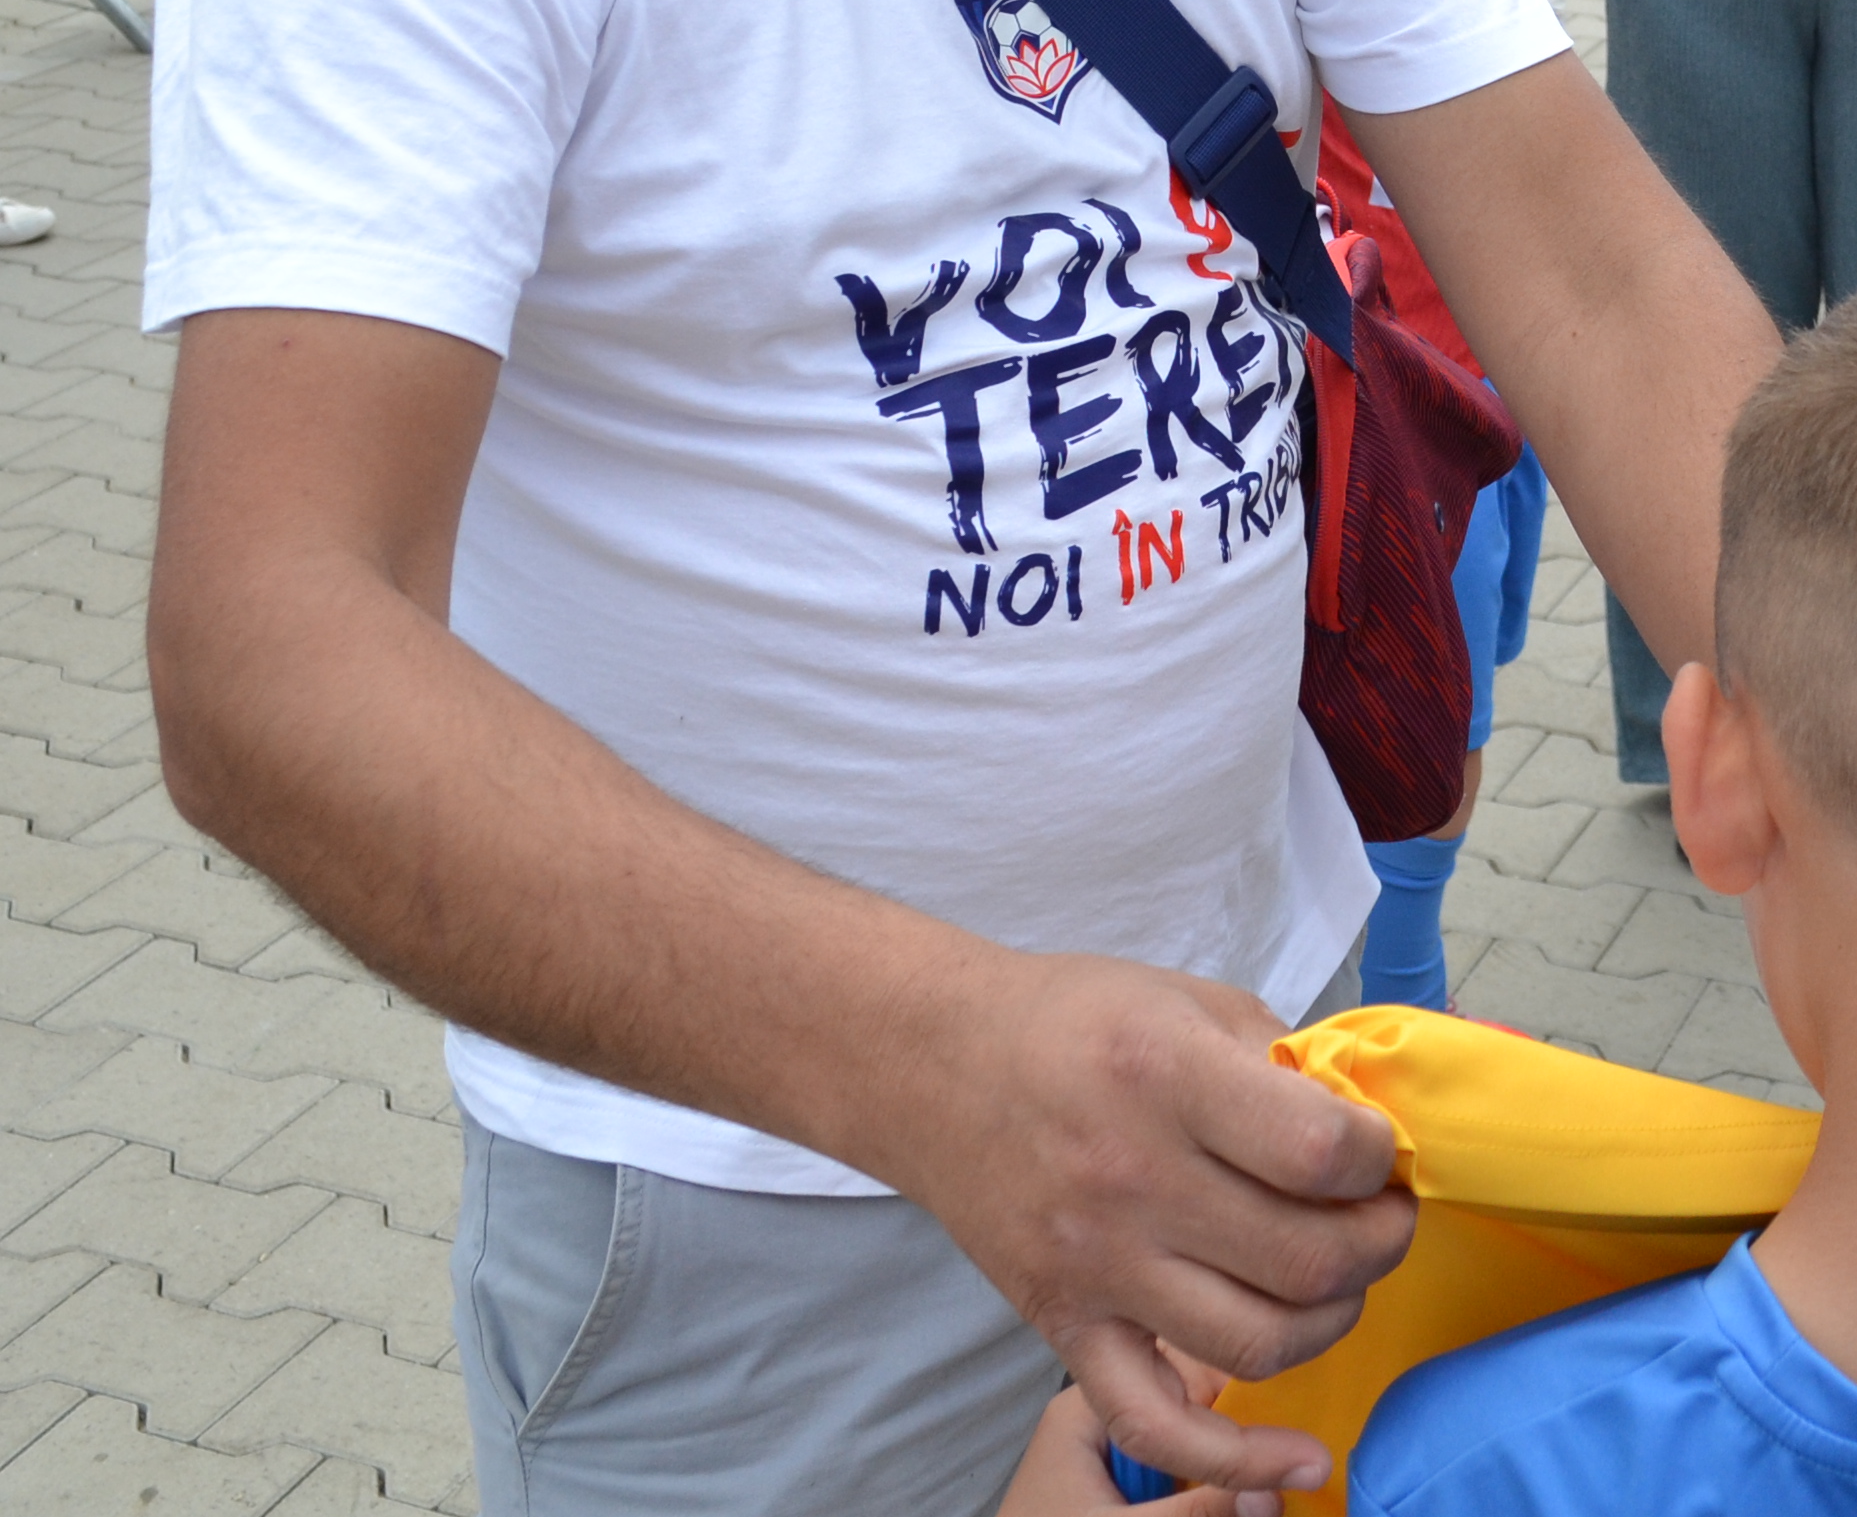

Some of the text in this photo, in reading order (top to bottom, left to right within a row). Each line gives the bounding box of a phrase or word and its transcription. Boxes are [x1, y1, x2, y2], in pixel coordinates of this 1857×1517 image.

[835, 198, 1157, 388] VOI
[923, 545, 1083, 638] NOI
[1112, 509, 1185, 606] ÎN
